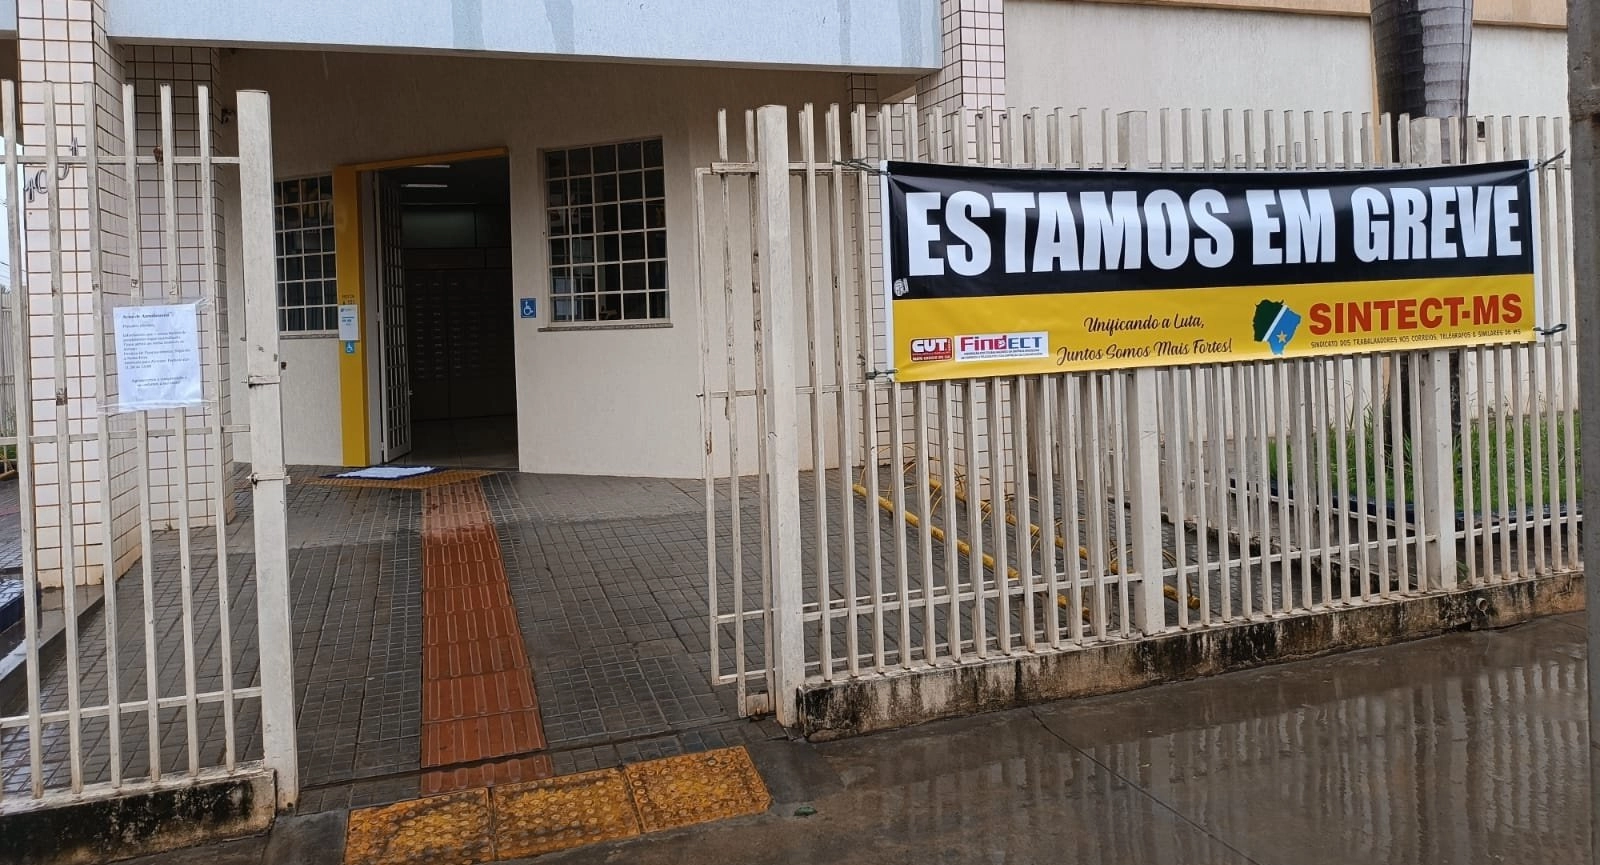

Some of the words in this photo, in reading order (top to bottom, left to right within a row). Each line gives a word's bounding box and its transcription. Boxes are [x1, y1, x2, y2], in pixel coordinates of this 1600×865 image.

[905, 188, 1235, 277] ESTAMOS
[1246, 188, 1337, 265] EM
[1351, 185, 1523, 262] GREVE
[1084, 315, 1160, 336] Unificando
[1162, 318, 1171, 329] a
[1173, 313, 1205, 329] Luta,
[1308, 293, 1523, 335] SINTECT-MS
[911, 338, 948, 353] CUT
[1056, 346, 1103, 366] Juntos
[1105, 343, 1150, 360] Somos
[1153, 341, 1190, 357] Mais
[1192, 337, 1233, 354] Fortes!
[1310, 340, 1338, 348] SINDICATO
[1340, 339, 1351, 347] DOS
